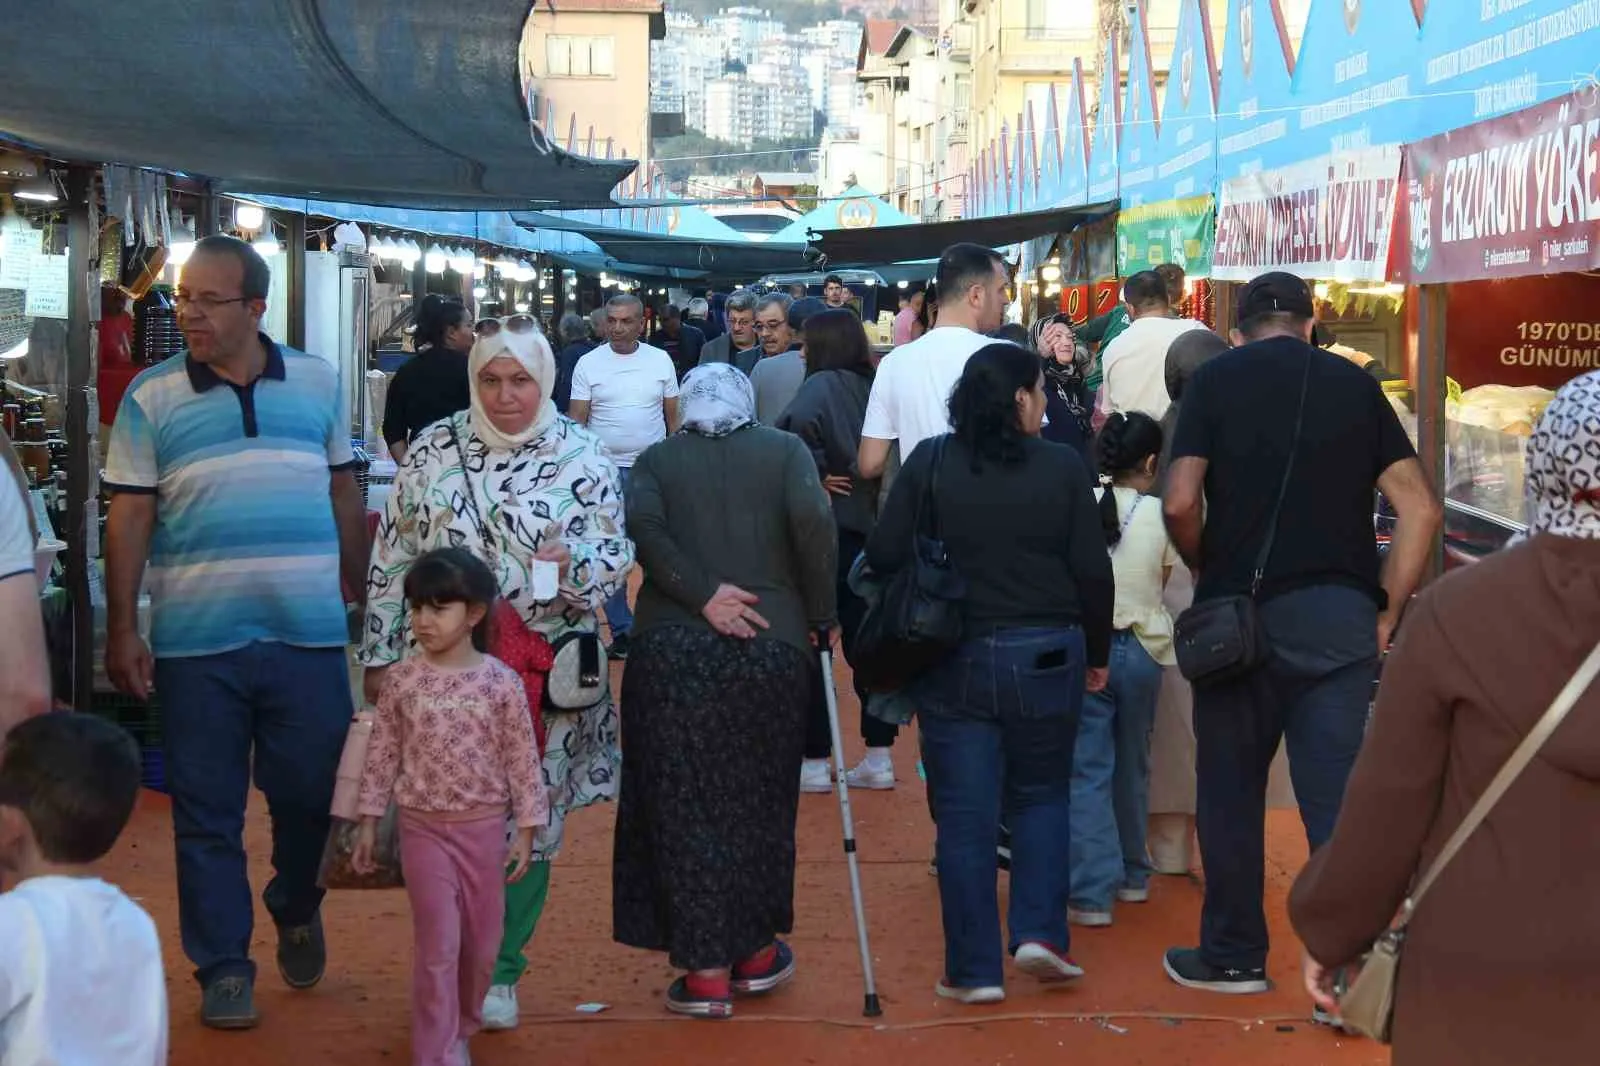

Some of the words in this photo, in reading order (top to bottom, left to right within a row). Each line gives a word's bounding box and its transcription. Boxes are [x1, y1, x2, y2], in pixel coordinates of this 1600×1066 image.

[1212, 198, 1266, 267] ERZURUM
[1269, 175, 1321, 266] YÖRESEL
[1441, 137, 1533, 242] ERZURUM
[1535, 101, 1600, 228] YÖRE
